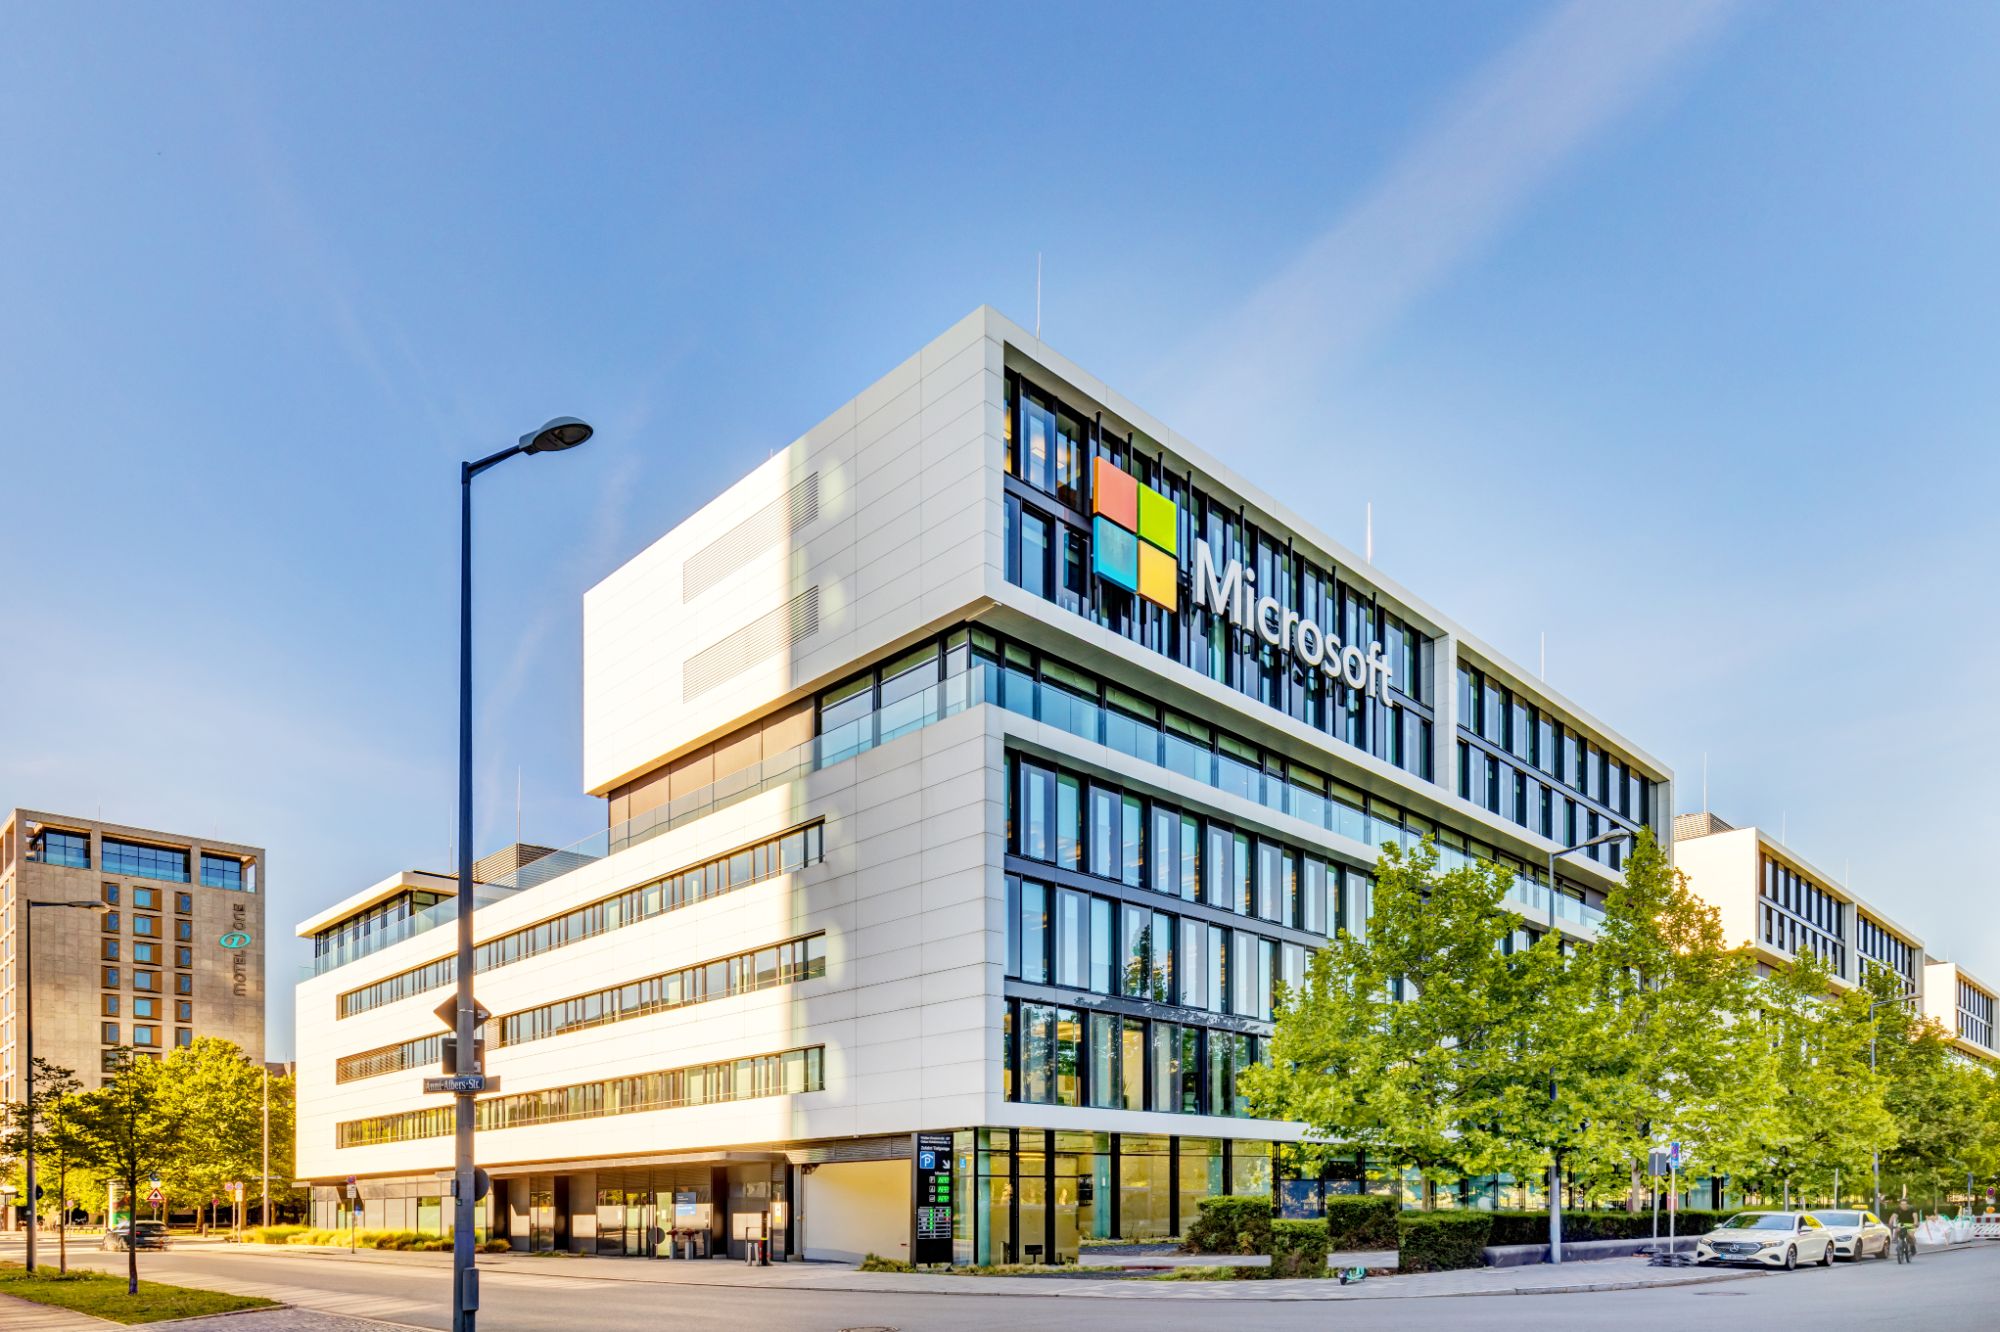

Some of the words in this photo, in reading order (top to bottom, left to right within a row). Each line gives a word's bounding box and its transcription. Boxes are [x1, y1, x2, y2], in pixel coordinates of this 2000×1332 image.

[1192, 538, 1393, 707] Microsoft
[233, 904, 245, 930] ONE
[233, 949, 246, 996] MOTEL
